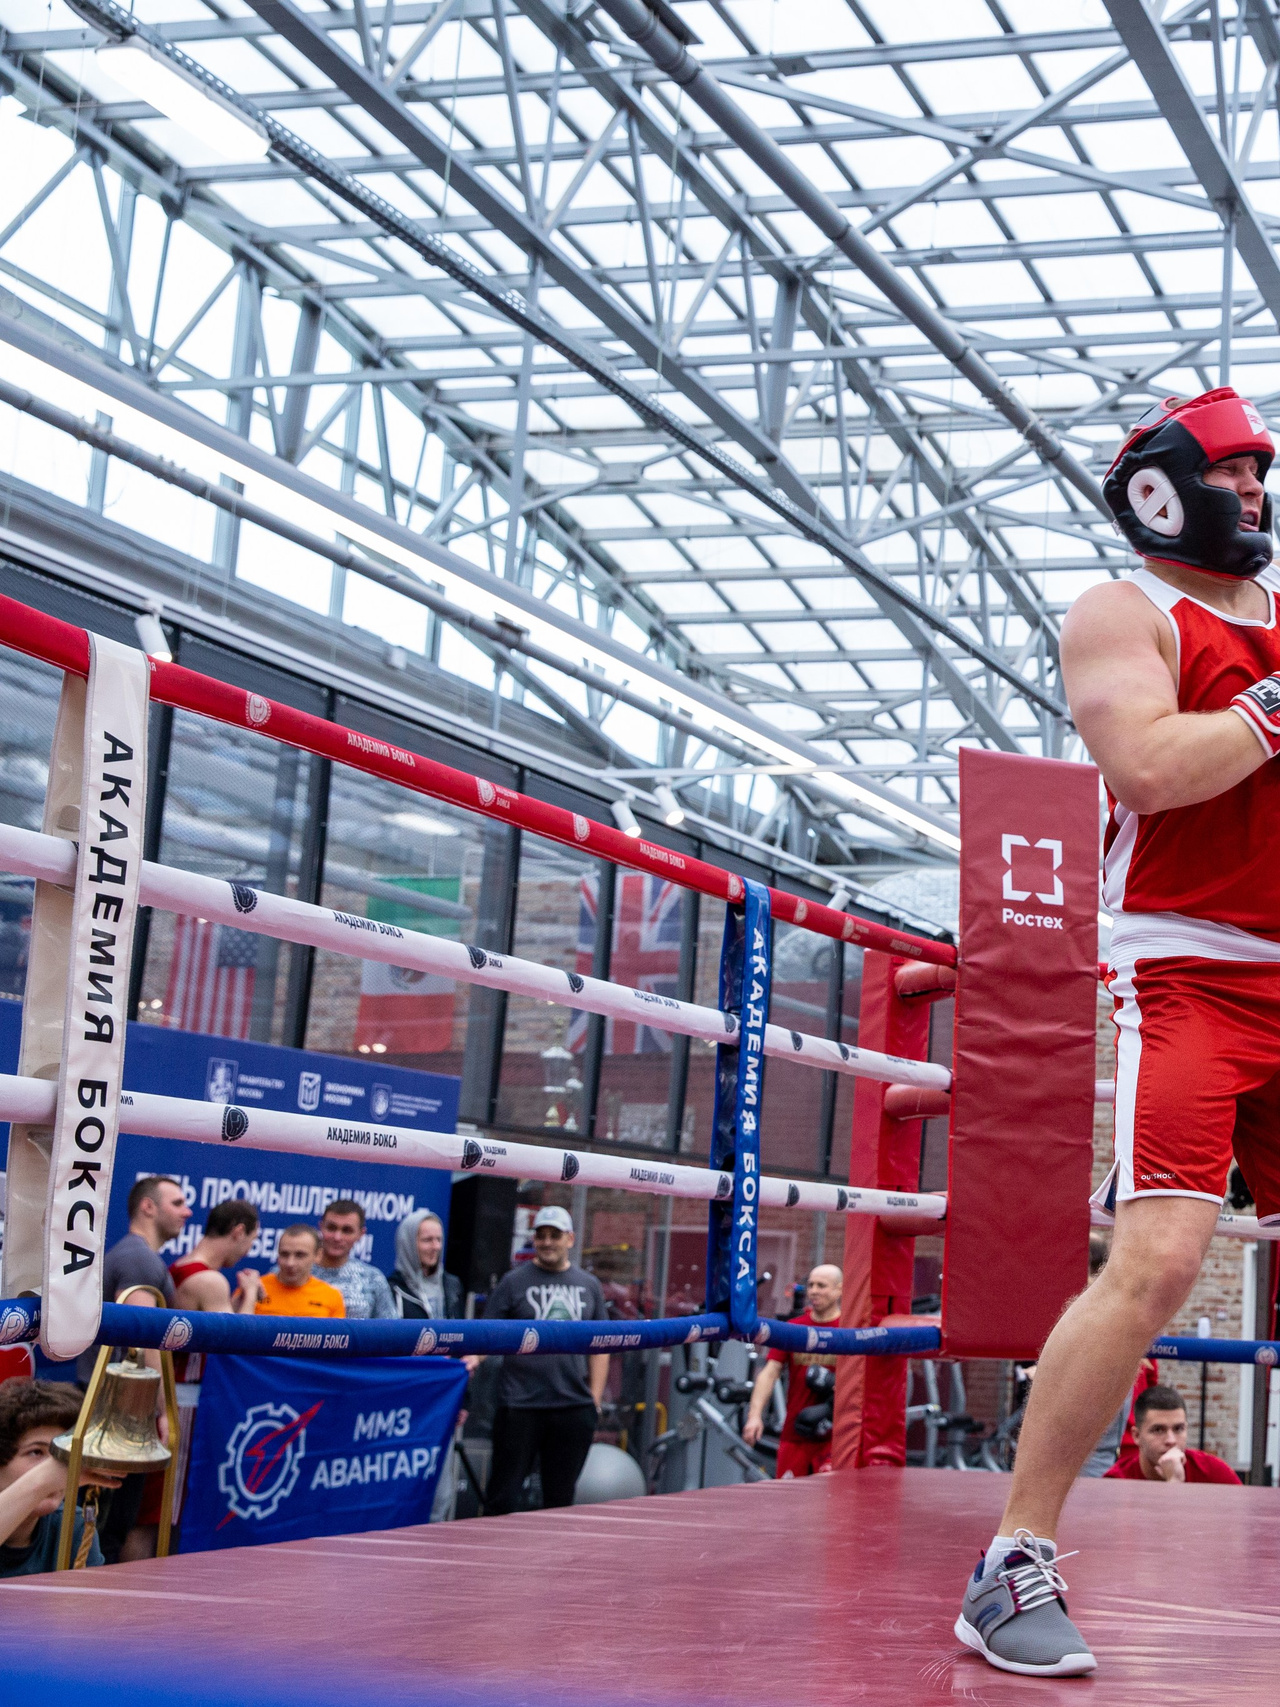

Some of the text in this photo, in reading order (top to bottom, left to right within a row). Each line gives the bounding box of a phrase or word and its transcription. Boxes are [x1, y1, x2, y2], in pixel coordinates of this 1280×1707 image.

[347, 732, 416, 768] АКАДЕМИЯ БОКСА
[332, 911, 405, 939] АКАДЕМИЯ БОКСА
[1002, 908, 1064, 930] Ростех
[62, 730, 134, 1276] АКАДЕМИЯ БОКСА
[737, 927, 767, 1280] АКАДЕМИЯ БОКСА
[326, 1126, 398, 1149] АКАДЕМИЯ БОКСА
[272, 1332, 350, 1350] АКАДЕМИЯ БОКСА
[353, 1406, 412, 1442] ММЗ
